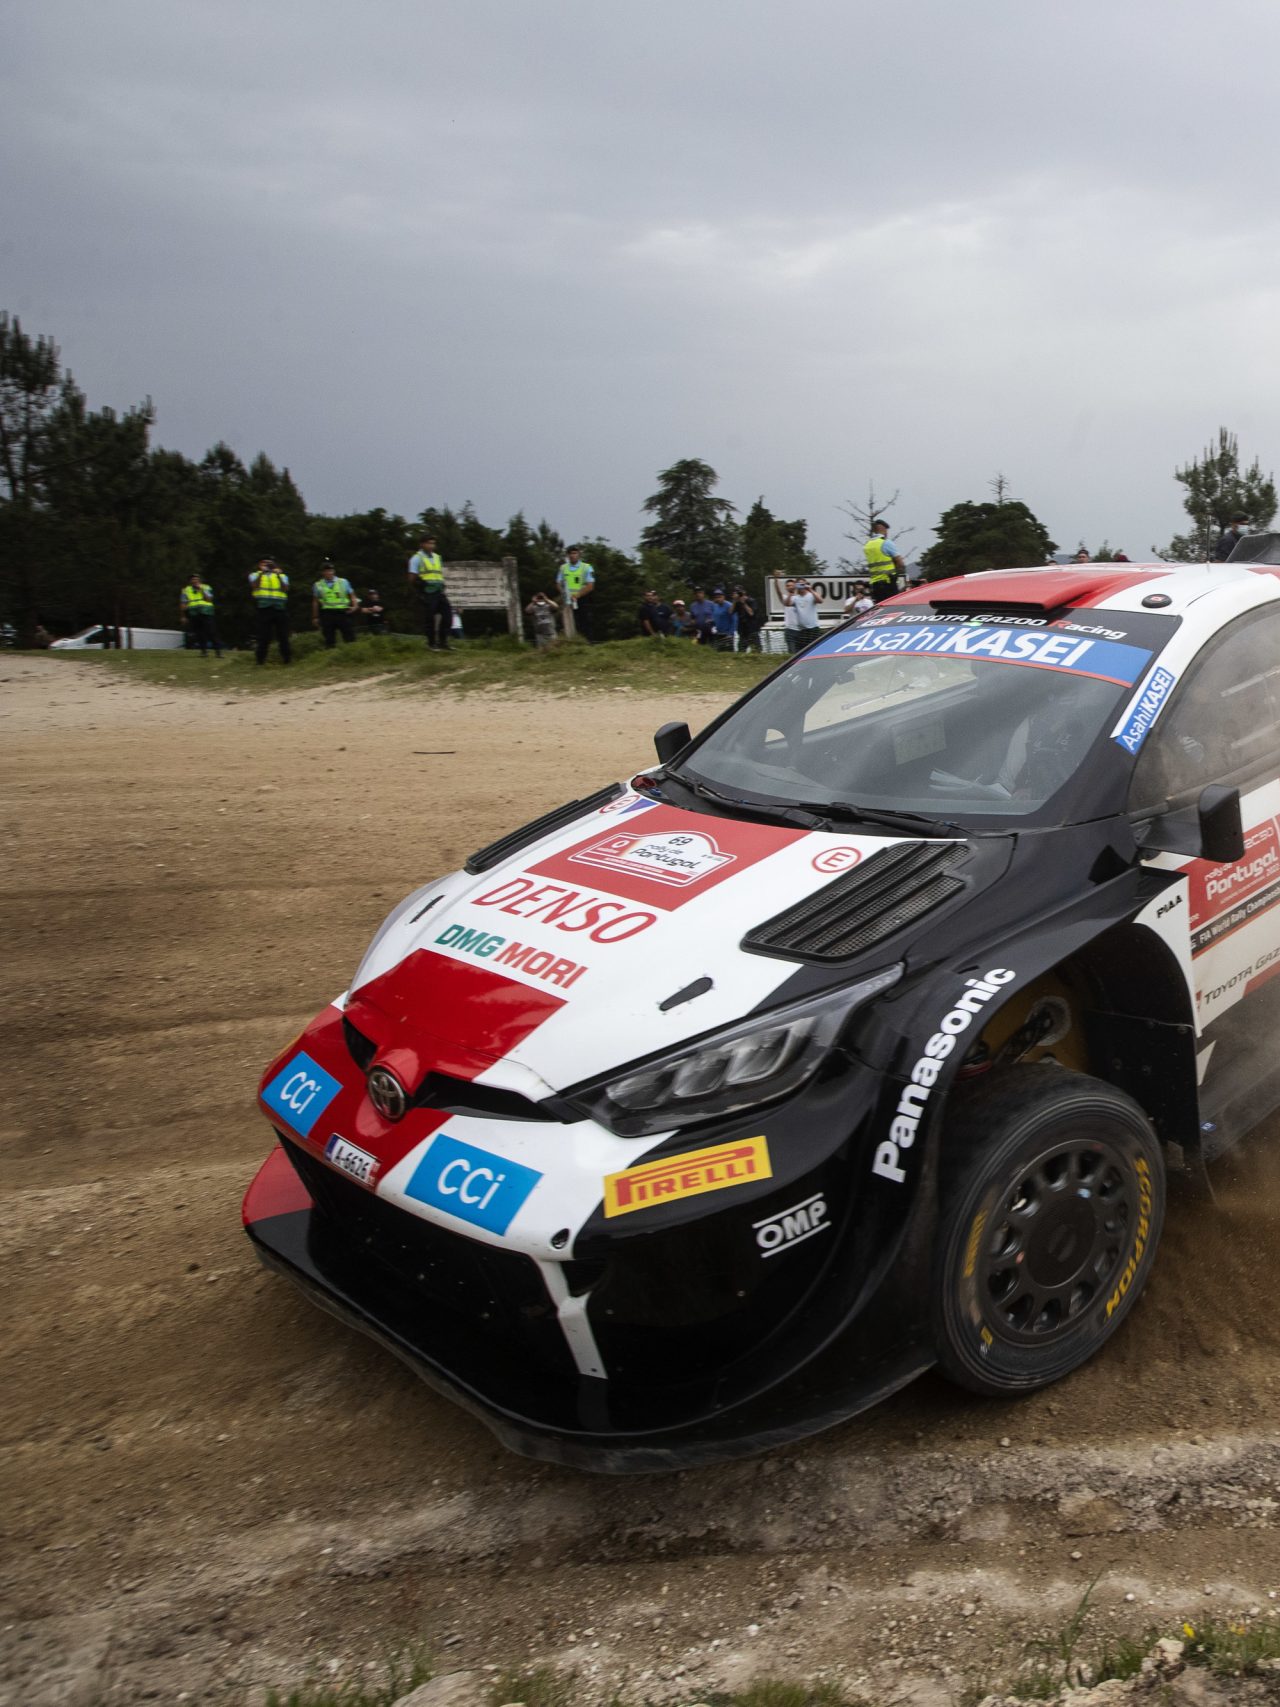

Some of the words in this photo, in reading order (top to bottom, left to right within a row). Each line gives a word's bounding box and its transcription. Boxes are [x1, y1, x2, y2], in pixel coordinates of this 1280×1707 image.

[835, 626, 1095, 668] AsahiKASEI
[897, 613, 967, 623] TOYOTA
[972, 613, 1047, 627] GAZOO
[1050, 618, 1127, 640] Racing
[1122, 669, 1174, 751] AsahiKASEI
[630, 848, 701, 869] Portugal
[668, 836, 693, 846] 69
[822, 851, 850, 868] E
[1206, 846, 1279, 901] Portugal
[470, 877, 657, 944] DENSO
[1156, 895, 1183, 918] PIAA
[434, 924, 505, 957] DMG
[493, 941, 589, 989] MORI
[1204, 965, 1253, 1004] TOYOTA
[872, 968, 1016, 1184] Panasonic
[615, 1145, 756, 1207] PIRELLI
[756, 1200, 828, 1249] OMP
